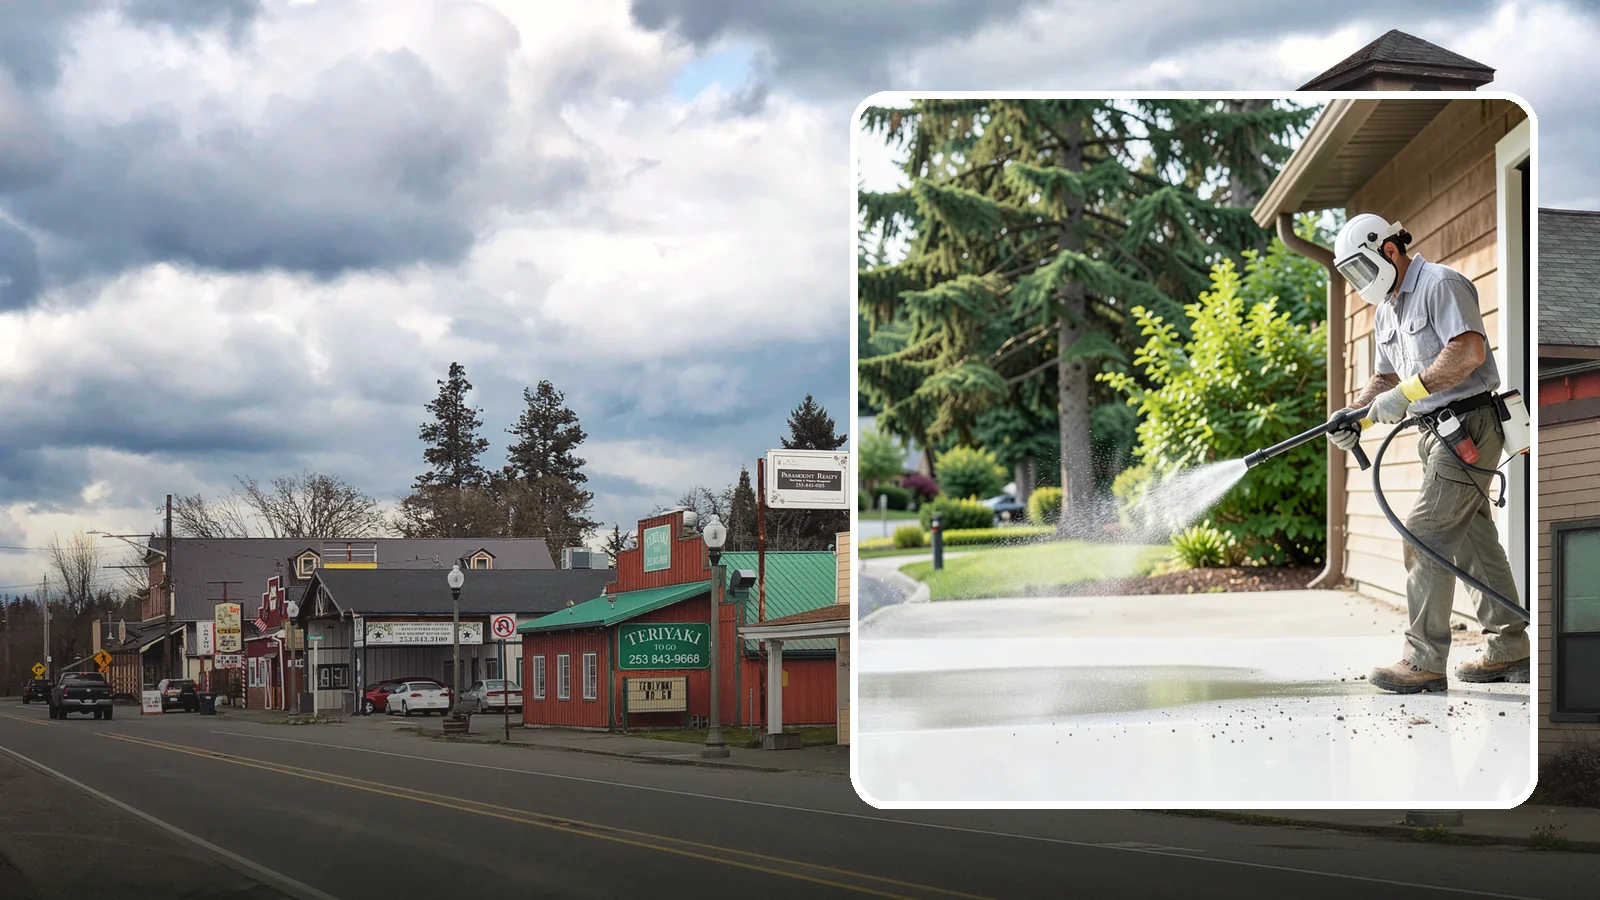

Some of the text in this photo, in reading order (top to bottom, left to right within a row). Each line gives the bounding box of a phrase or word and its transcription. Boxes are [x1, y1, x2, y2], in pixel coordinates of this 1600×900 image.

[625, 628, 702, 646] TERIYAKI
[629, 654, 700, 664] 253 843-9668
